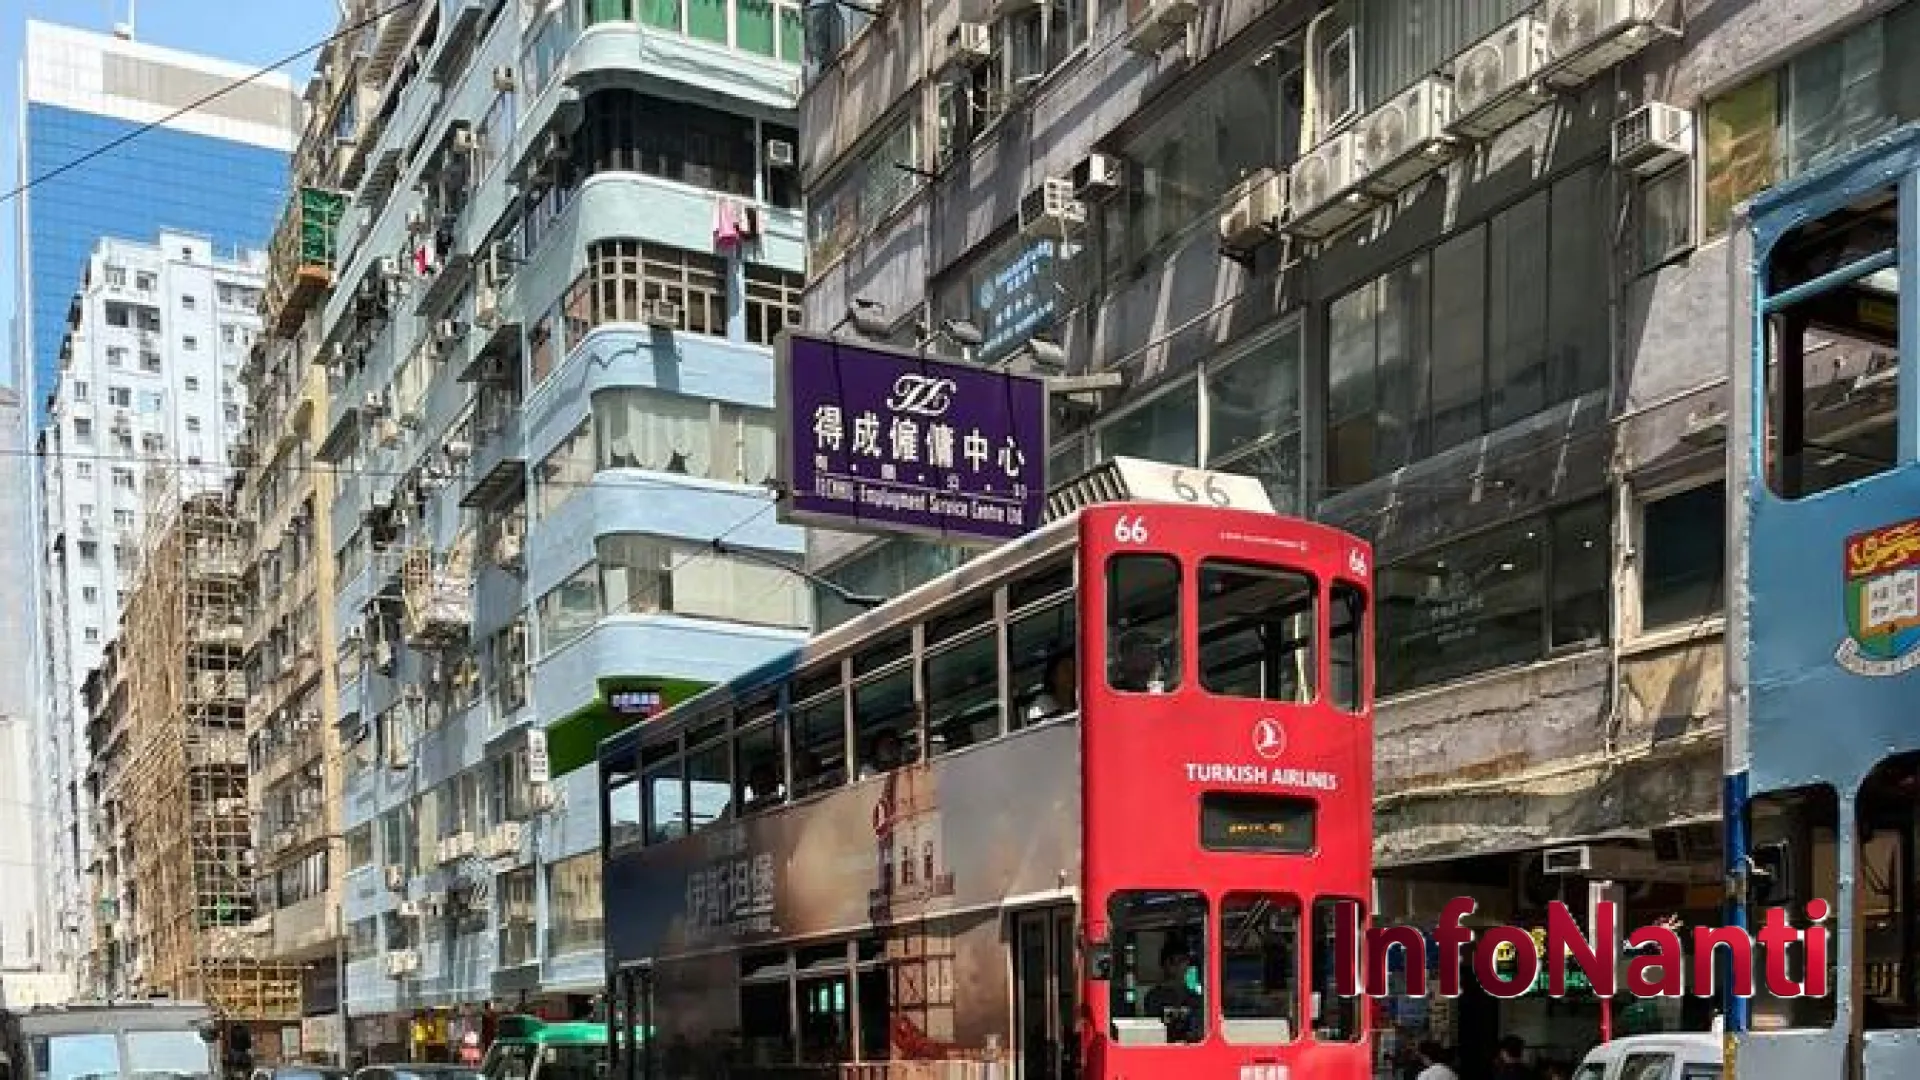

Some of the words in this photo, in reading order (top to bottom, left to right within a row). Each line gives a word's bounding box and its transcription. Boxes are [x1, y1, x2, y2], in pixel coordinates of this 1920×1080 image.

[860, 483, 927, 511] Employment
[929, 492, 968, 517] Service
[1172, 470, 1231, 506] 66
[1114, 515, 1148, 544] 66
[1186, 763, 1268, 784] TURKISH
[1271, 768, 1337, 791] AIRLINES
